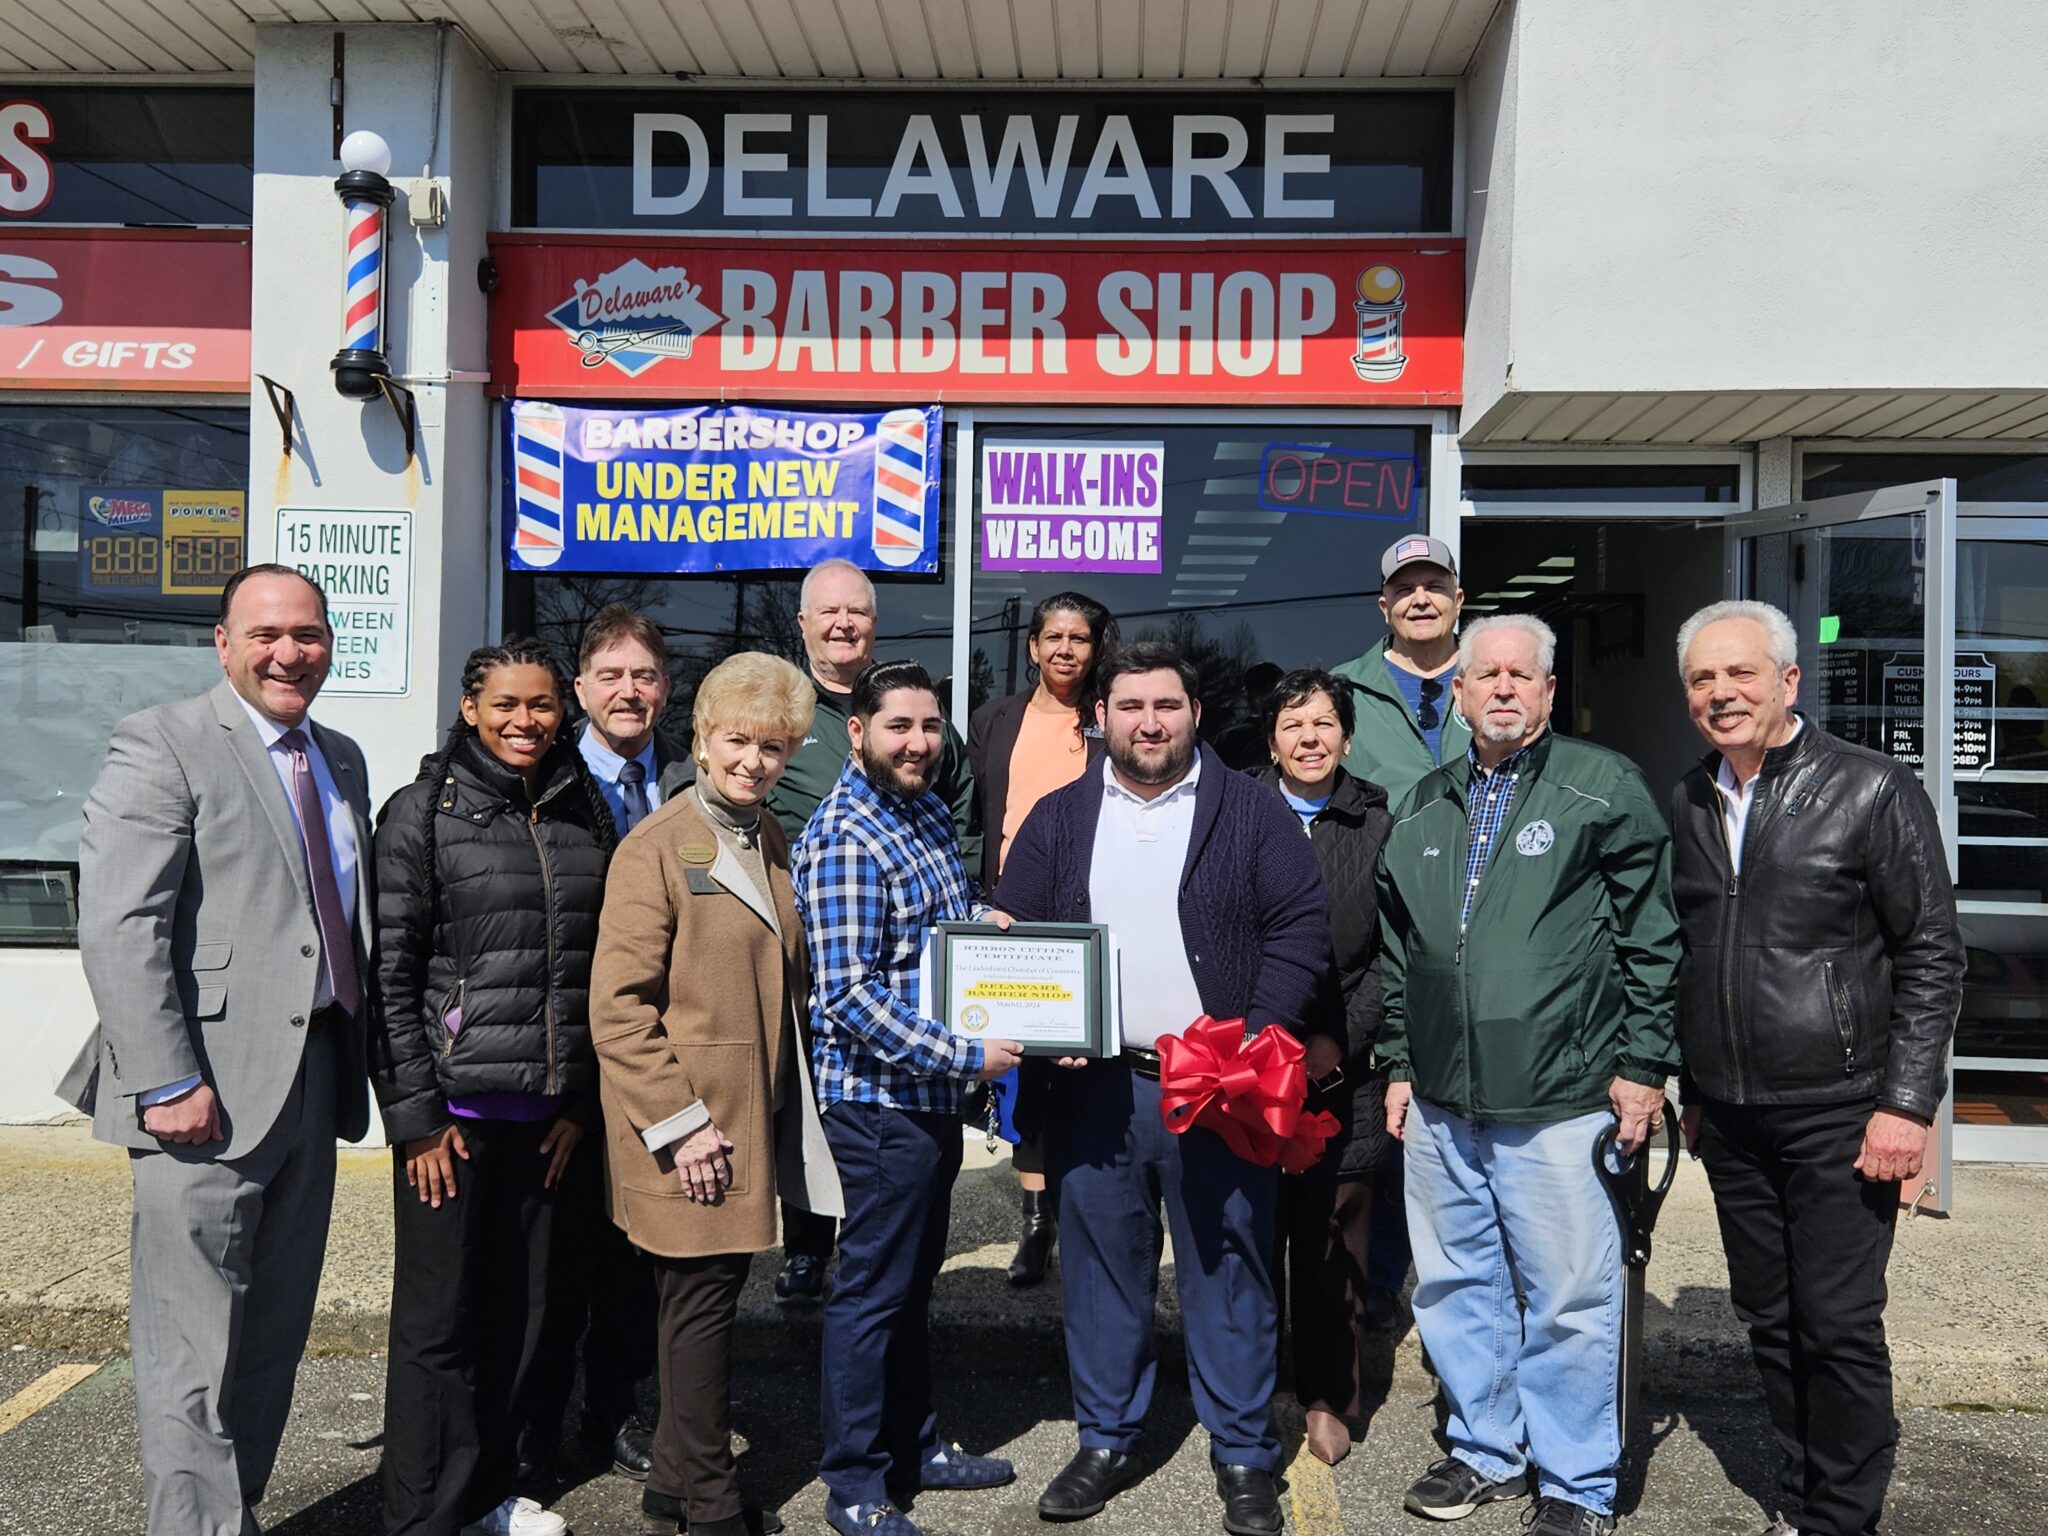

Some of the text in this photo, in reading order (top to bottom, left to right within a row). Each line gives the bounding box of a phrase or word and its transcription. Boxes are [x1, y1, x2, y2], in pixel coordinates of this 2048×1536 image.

[632, 112, 1336, 220] DELAWARE
[581, 281, 684, 320] Delaware
[719, 267, 1338, 378] BARBER SHOP
[62, 341, 196, 369] GIFTS
[585, 416, 865, 451] BARBERSHOP
[596, 460, 840, 501] UNDER NEW
[988, 451, 1158, 508] WALK-INS
[1268, 454, 1413, 512] OPEN
[108, 498, 151, 517] MEGA
[171, 507, 228, 517] POWER
[576, 501, 860, 543] MANAGEMENT
[287, 523, 402, 555] 15 MINUTE
[986, 519, 1158, 561] WELCOME
[297, 563, 390, 596] PARKING
[327, 611, 394, 630] WEEN
[336, 636, 378, 655] EEN
[1954, 668, 1981, 678] OURS
[1894, 684, 1920, 692] MON.
[1894, 696, 1920, 704] TUES.
[1893, 730, 1911, 740] FRI.
[1893, 742, 1915, 752] SAT.
[1953, 755, 1979, 765] OSED
[968, 990, 1028, 998] BARBER
[979, 983, 1060, 991] DELAWARE
